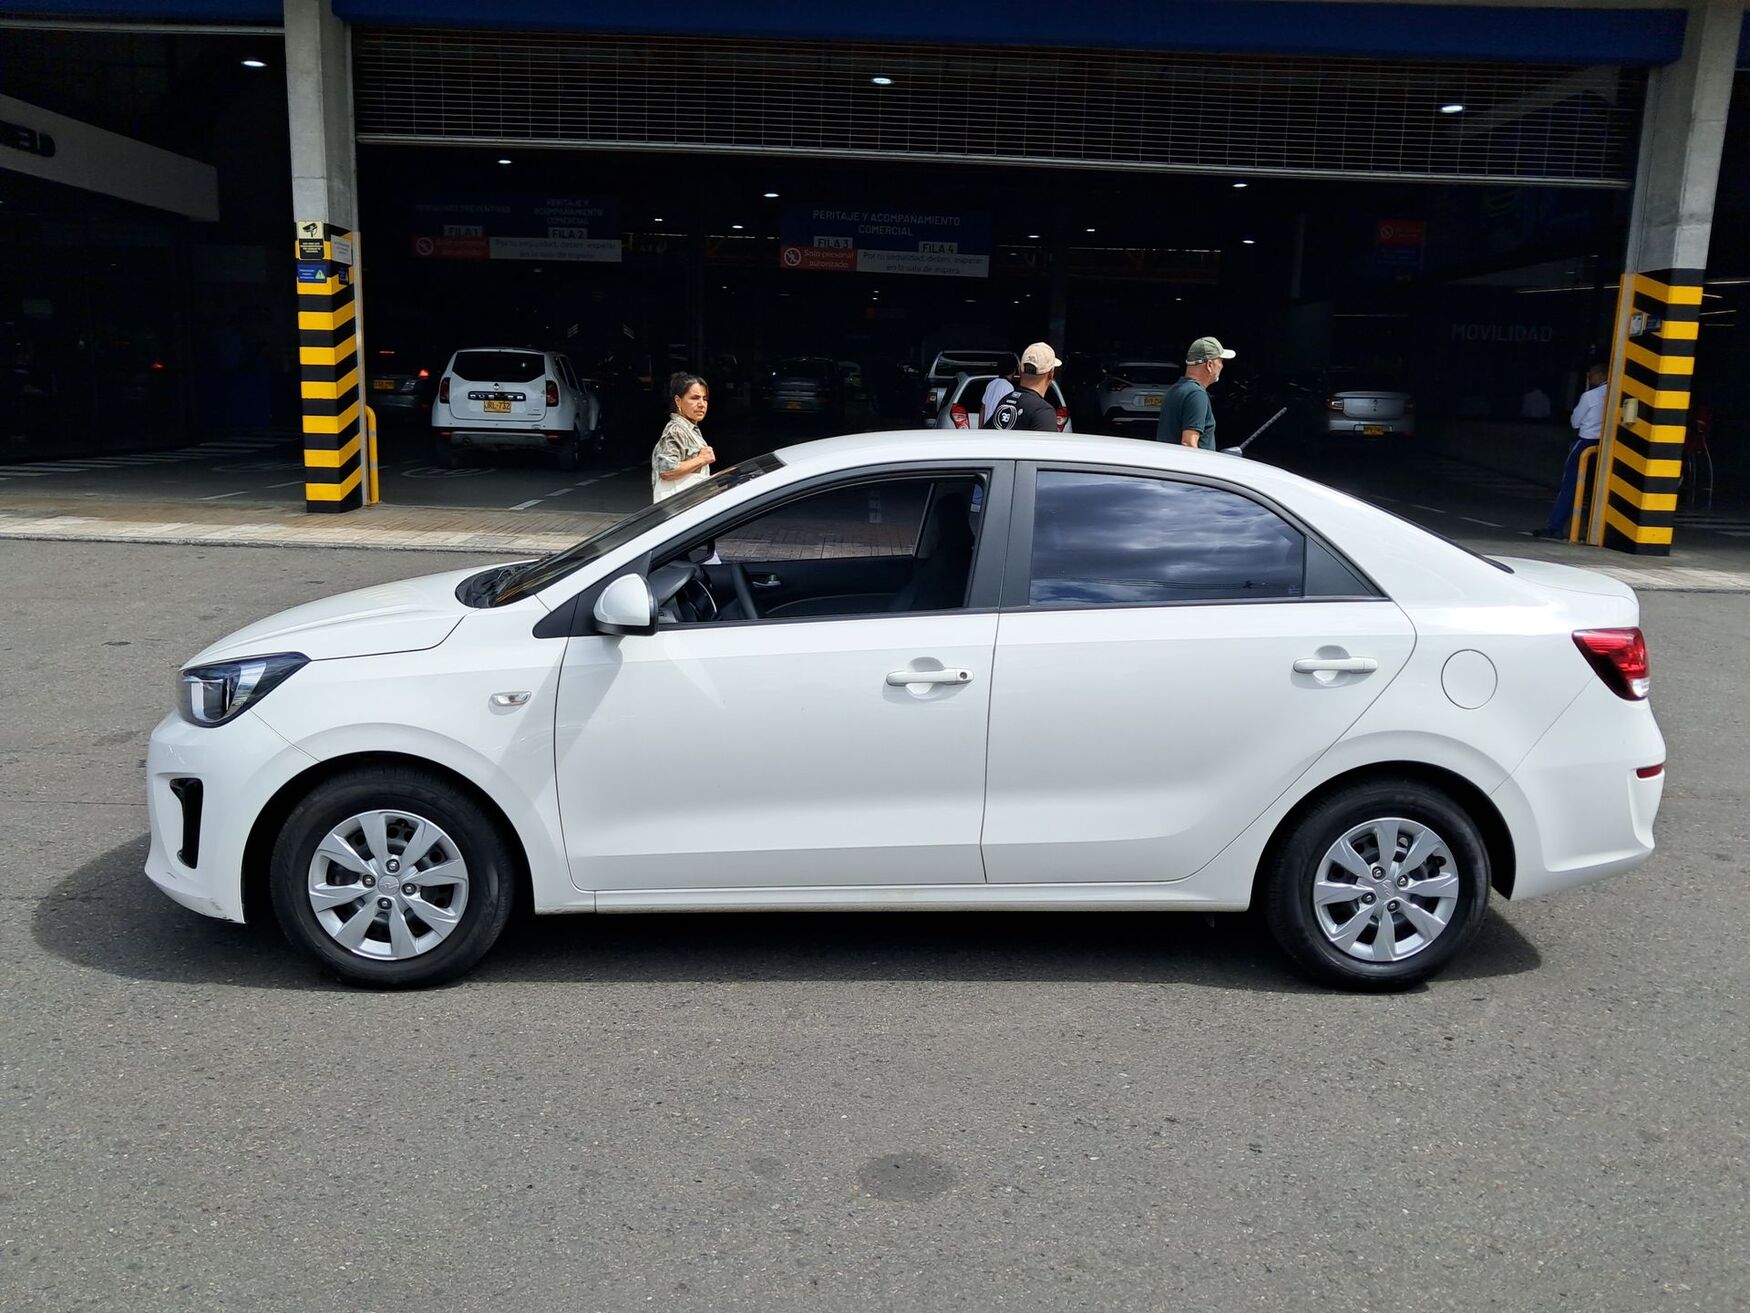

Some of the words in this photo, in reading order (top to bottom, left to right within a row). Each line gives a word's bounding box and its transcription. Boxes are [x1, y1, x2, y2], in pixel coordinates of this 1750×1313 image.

[812, 209, 860, 222] PERITAJE
[862, 212, 869, 222] Y
[552, 229, 574, 239] FILA
[576, 230, 583, 239] 2
[858, 225, 914, 236] COMERCIAL
[817, 239, 840, 248] FILA
[843, 239, 849, 248] 3
[922, 243, 945, 253] FILA
[947, 245, 954, 254] 4
[1450, 323, 1553, 342] MOVILIDAD
